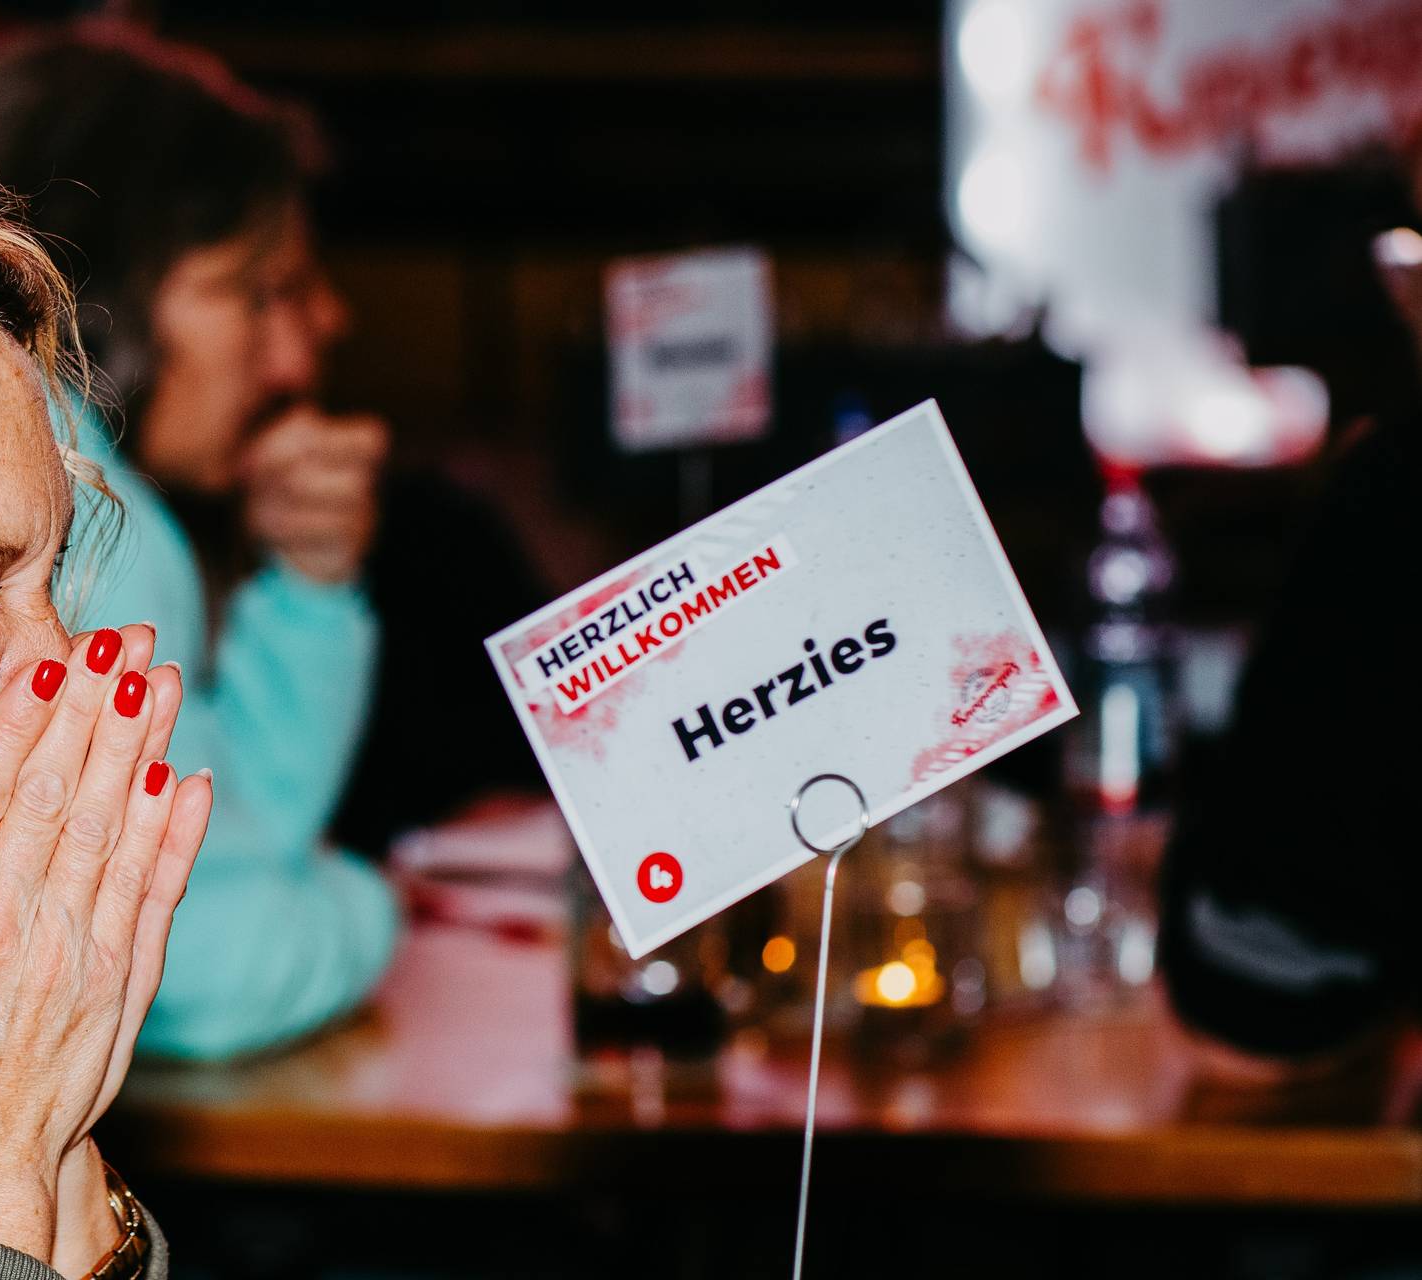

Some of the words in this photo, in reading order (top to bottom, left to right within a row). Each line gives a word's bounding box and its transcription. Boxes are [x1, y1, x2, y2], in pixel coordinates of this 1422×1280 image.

[536, 561, 695, 677] HERZLICH
[557, 547, 781, 702] WILLKOMMEN
[671, 618, 898, 763] Herzies
